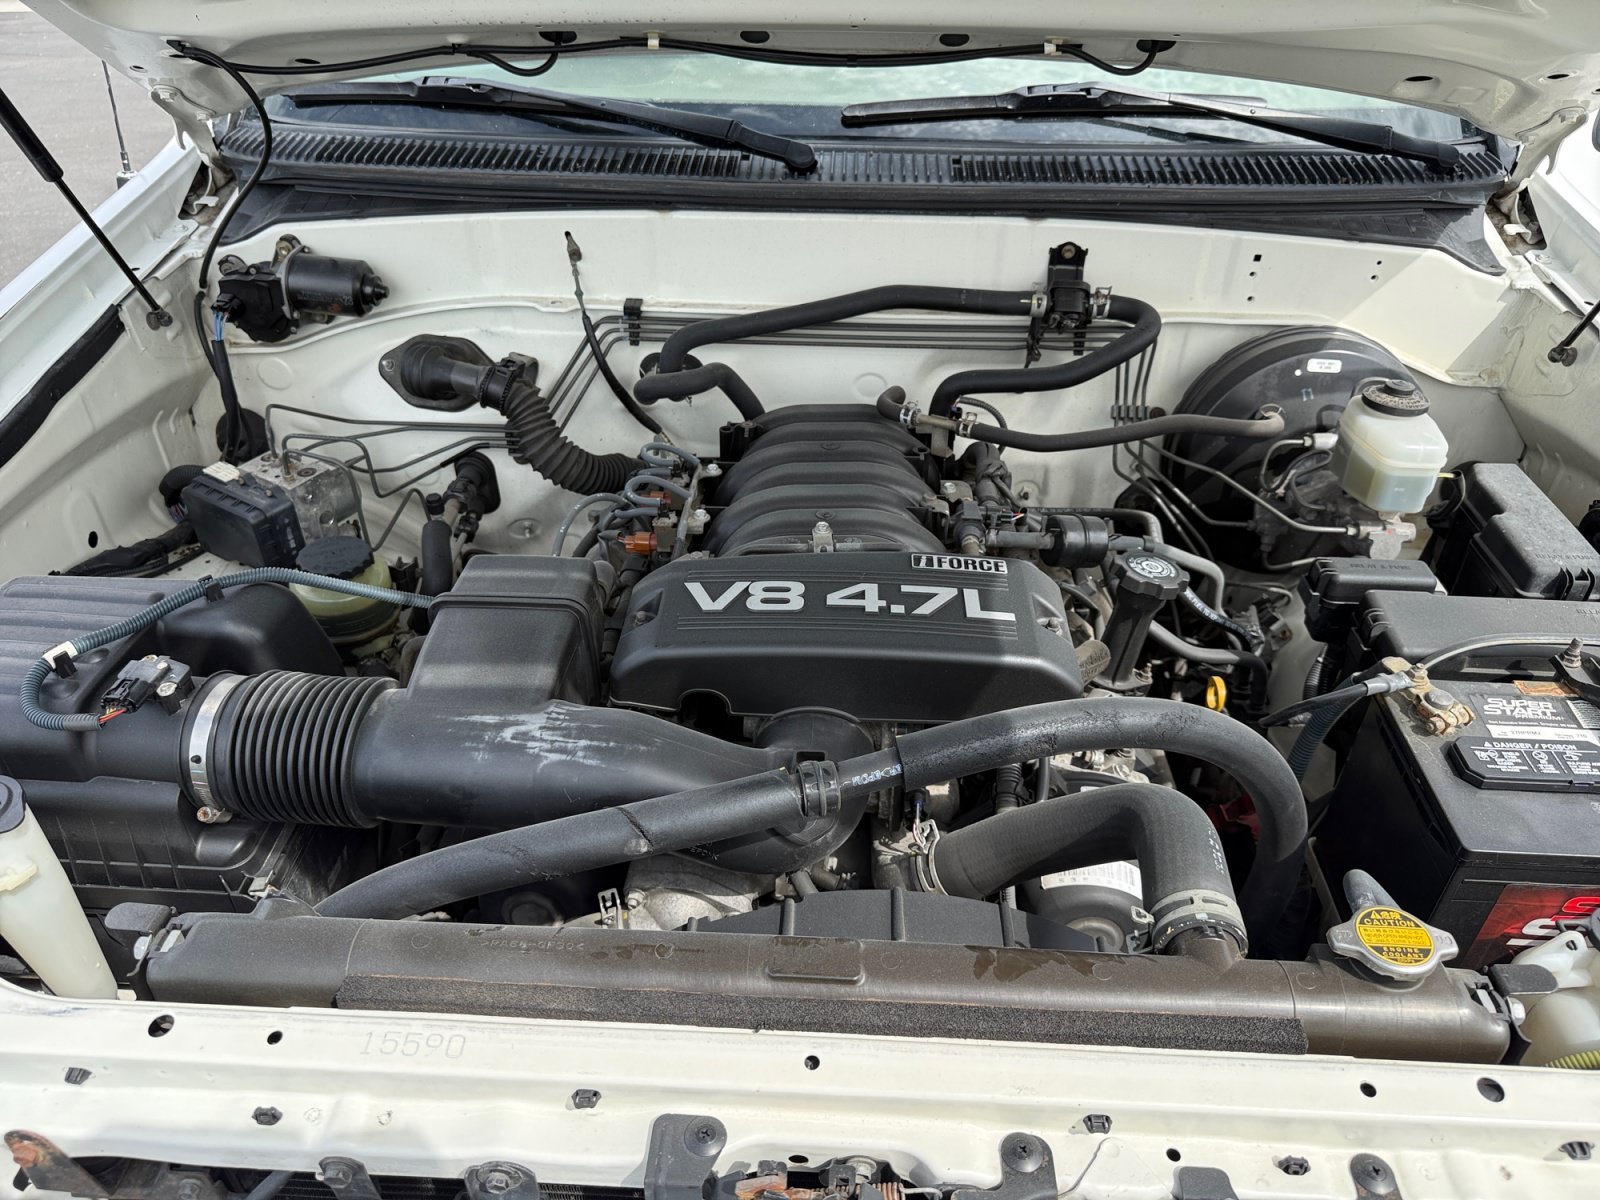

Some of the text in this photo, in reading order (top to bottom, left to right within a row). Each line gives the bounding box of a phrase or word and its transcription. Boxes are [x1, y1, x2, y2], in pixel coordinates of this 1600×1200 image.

[684, 581, 1016, 622] V8 4.7L
[1487, 698, 1553, 710] SUPER
[1484, 704, 1557, 717] START
[1492, 741, 1533, 749] DANGER
[1364, 919, 1415, 928] CAUTION
[1382, 951, 1425, 959] COOLANT
[360, 1031, 466, 1059] 15590
